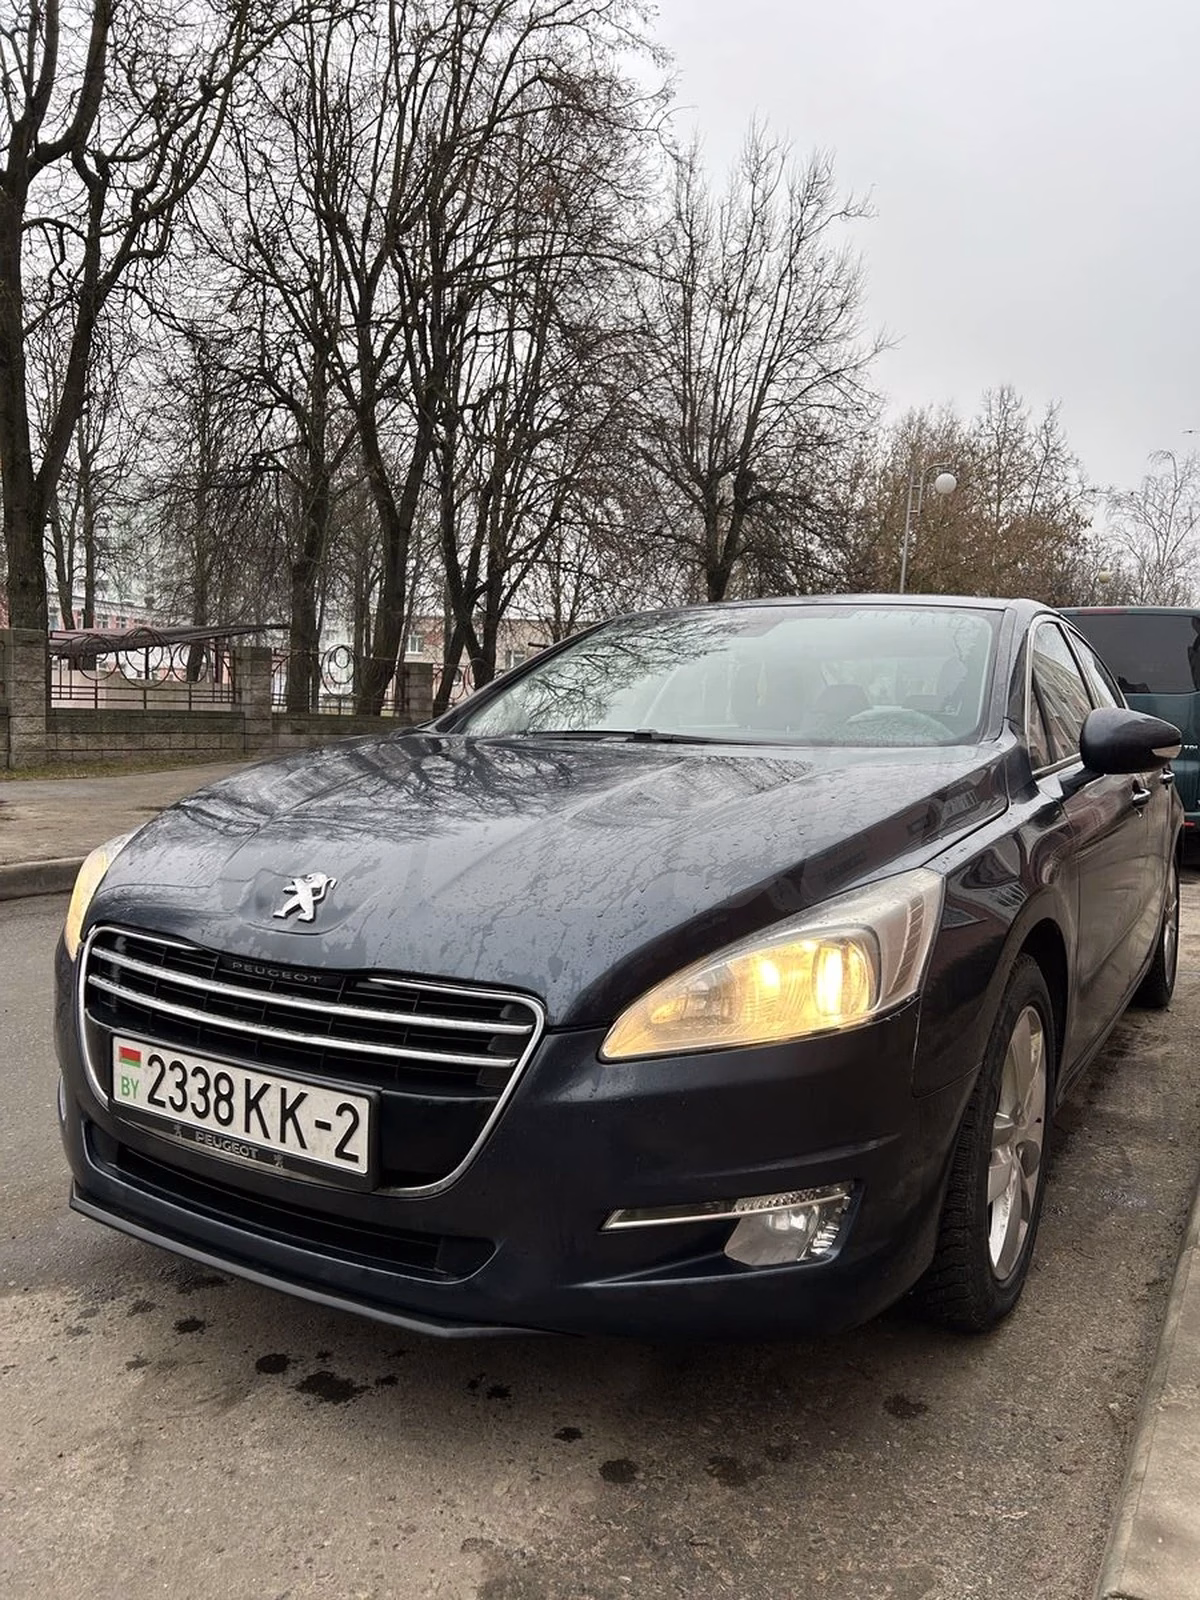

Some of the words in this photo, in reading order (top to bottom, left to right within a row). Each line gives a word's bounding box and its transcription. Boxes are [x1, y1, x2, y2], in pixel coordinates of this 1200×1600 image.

[232, 961, 322, 983] PEUGEOT
[121, 1075, 140, 1100] BY
[195, 1131, 259, 1159] PEUGEOT
